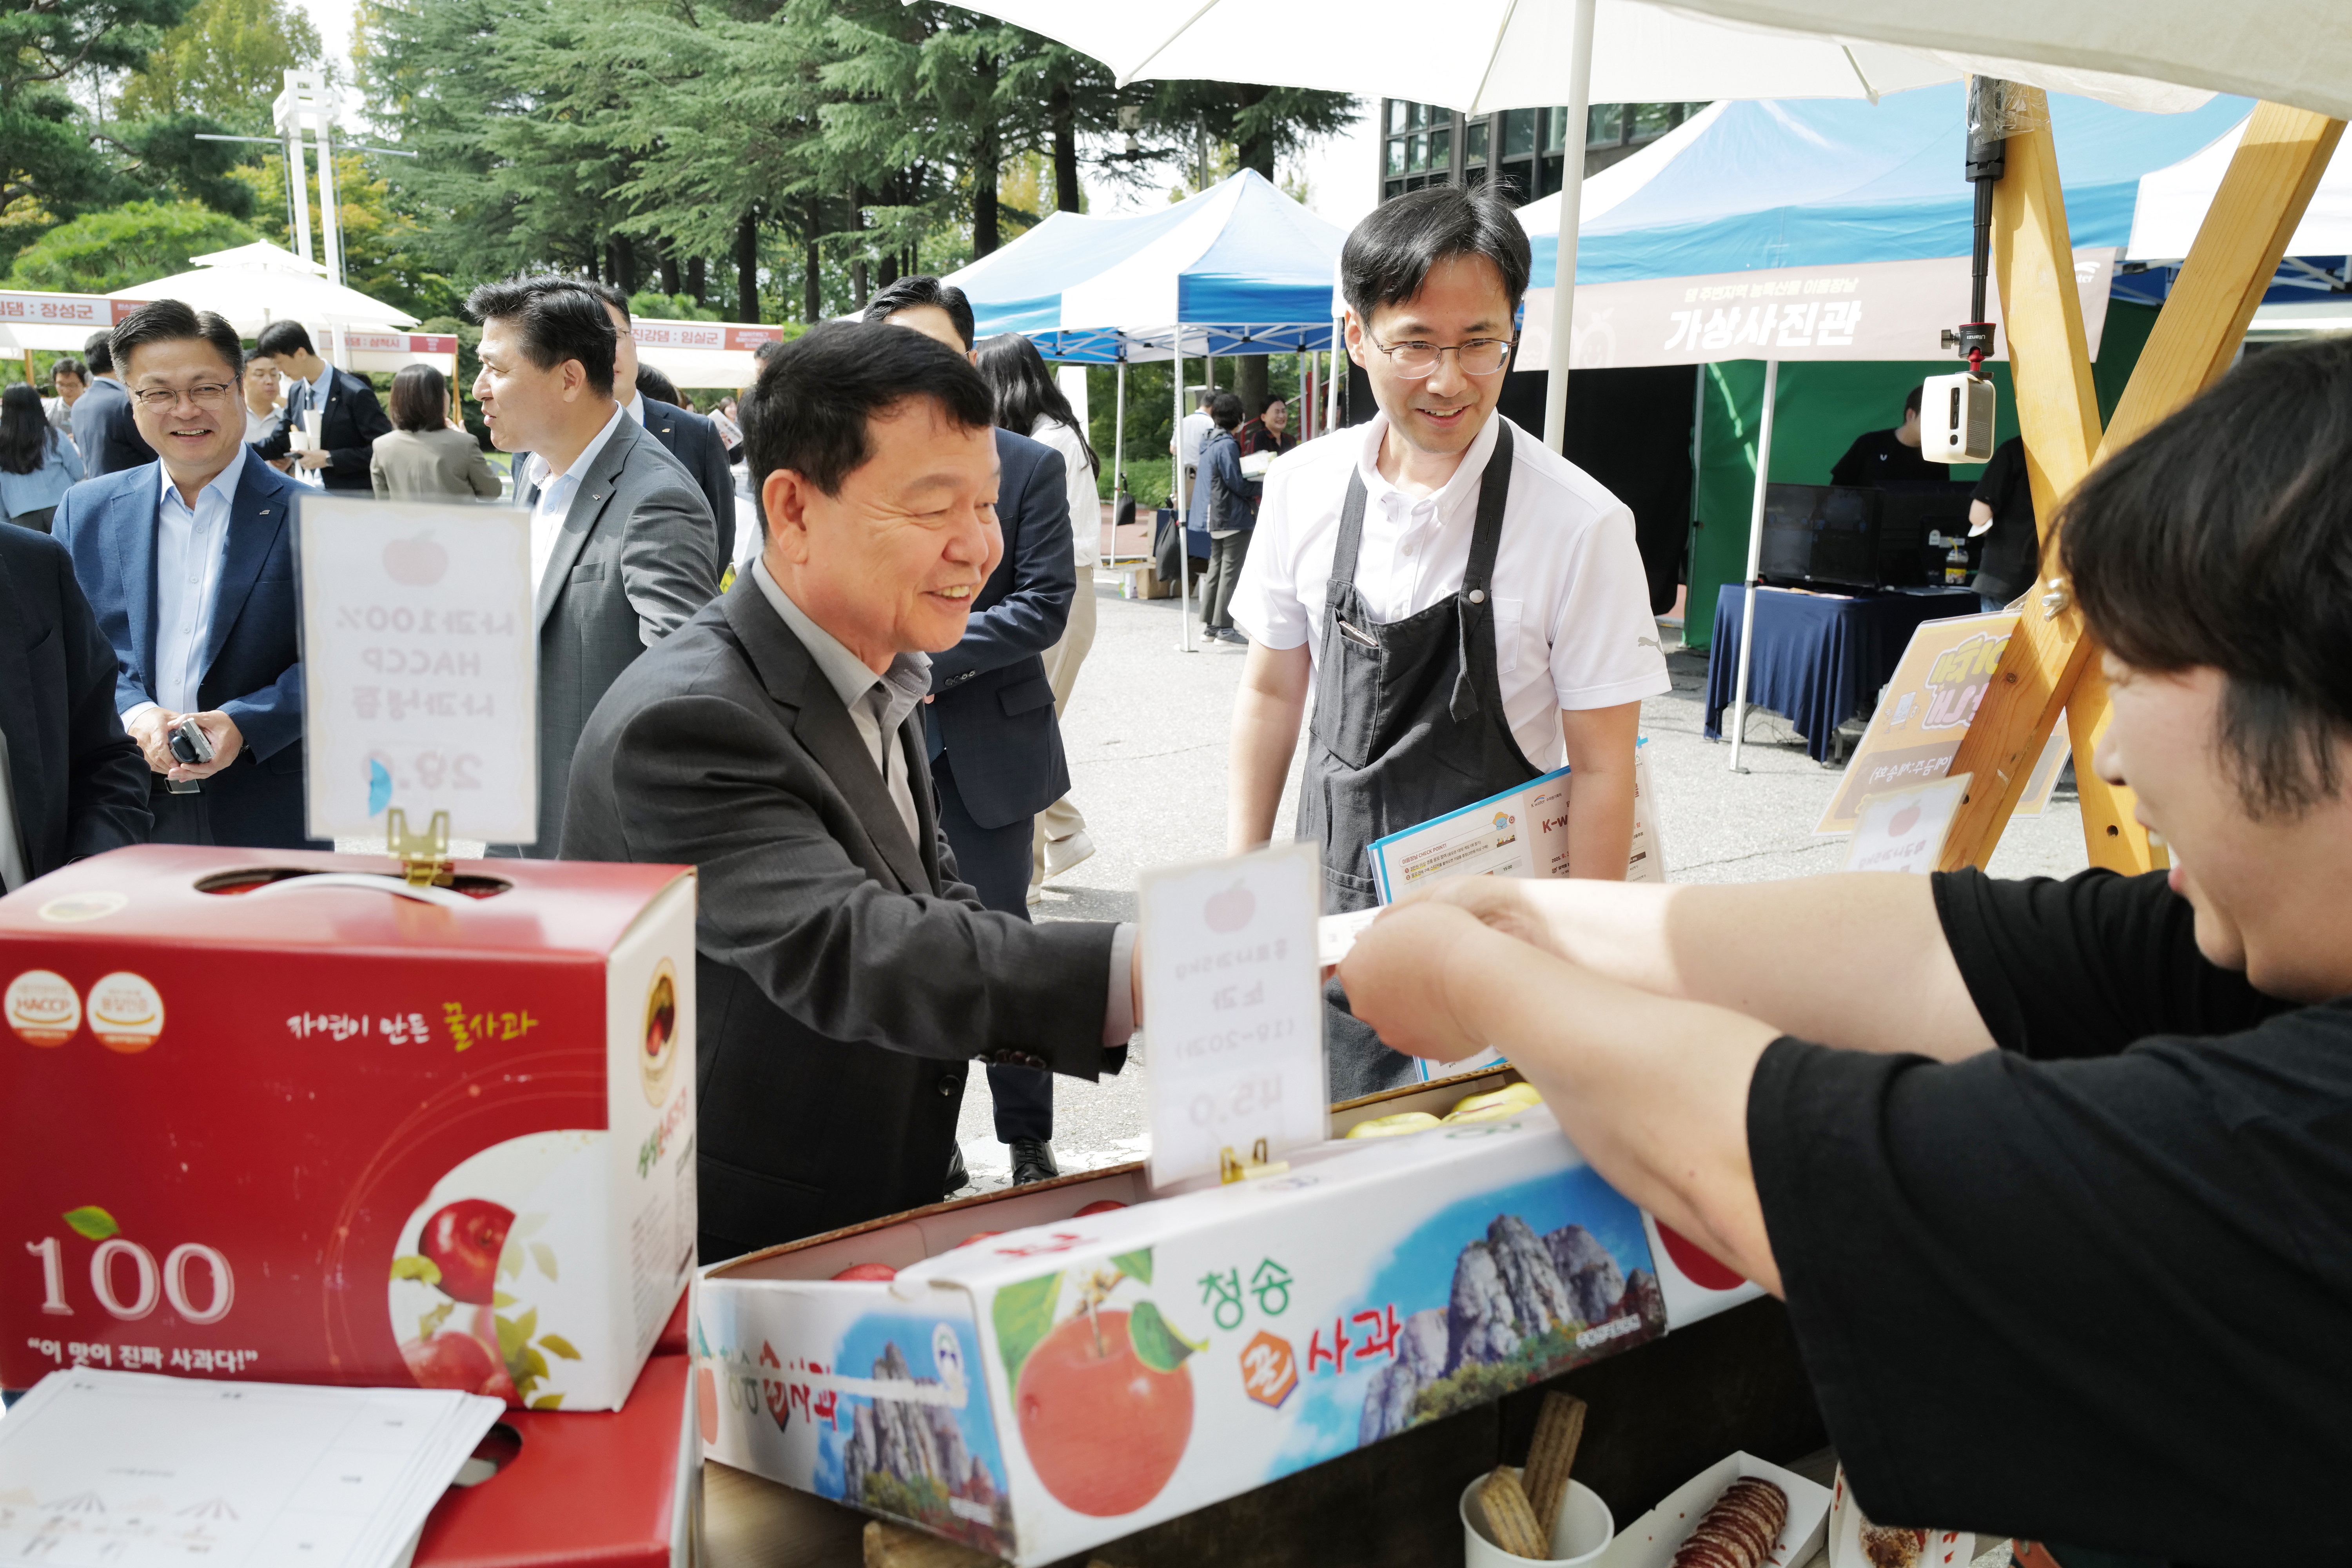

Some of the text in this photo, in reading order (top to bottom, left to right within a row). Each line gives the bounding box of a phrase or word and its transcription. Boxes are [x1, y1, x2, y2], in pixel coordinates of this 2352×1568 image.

[1699, 283, 1749, 302] 주변지역
[1749, 279, 1802, 298] 농특산물
[40, 303, 93, 319] 장성군
[1664, 300, 1862, 351] 가상사진관
[681, 331, 719, 345] 임실군
[1546, 793, 1562, 802] 수자원기획처
[1542, 814, 1568, 834] K-w
[1402, 843, 1447, 864] 이음장날 CHECK POINT!
[1430, 863, 1442, 871] 스티커를
[16, 997, 71, 1013] HACCP
[286, 1001, 539, 1052] 자연이 만든 꿀사과
[25, 1236, 236, 1326] 100
[1197, 1256, 1294, 1330] 청송
[1307, 1302, 1402, 1376] 사과
[68, 1342, 113, 1367] 맛이
[119, 1345, 163, 1370] 진짜
